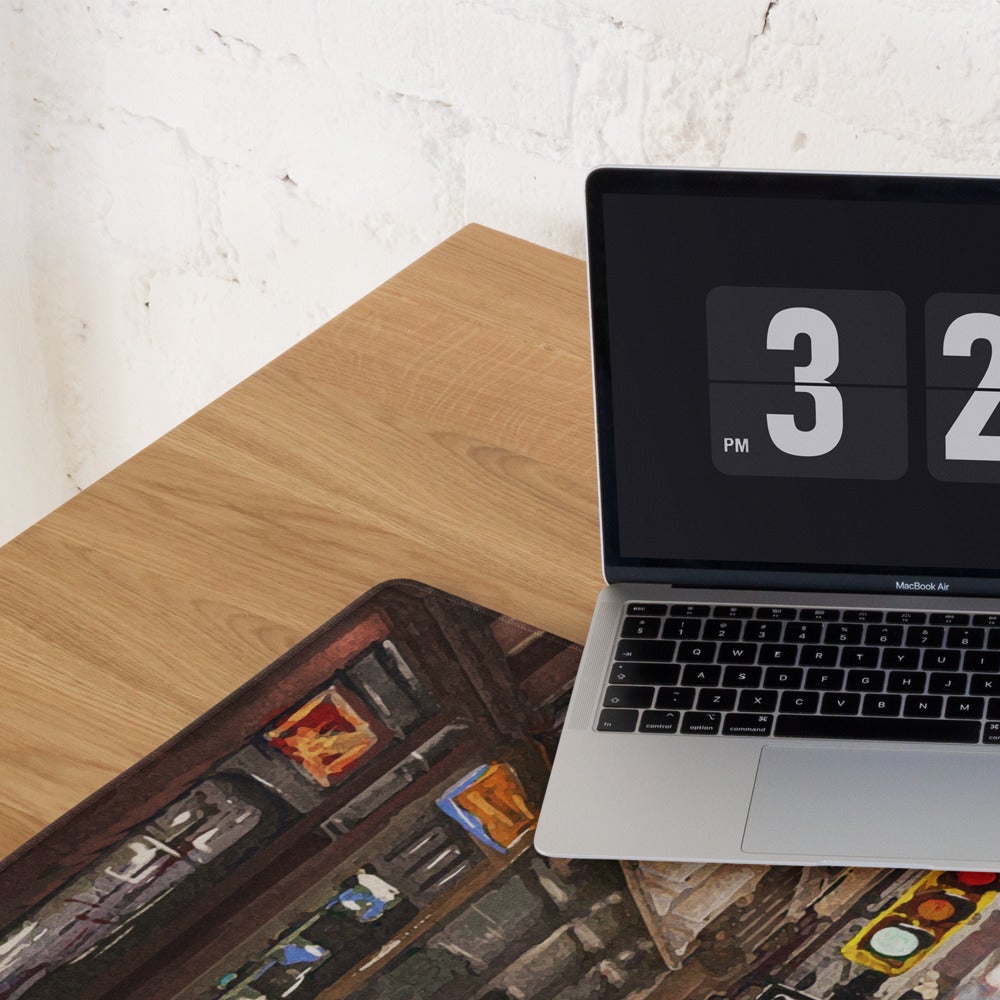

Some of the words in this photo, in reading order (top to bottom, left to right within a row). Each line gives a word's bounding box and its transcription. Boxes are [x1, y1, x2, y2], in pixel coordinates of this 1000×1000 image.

[766, 306, 844, 457] 3
[723, 437, 749, 454] PM
[895, 581, 936, 591] MacBook
[936, 582, 950, 591] Air
[692, 648, 701, 656] Q
[732, 649, 744, 657] W
[856, 653, 864, 661] T
[937, 656, 946, 664] U
[697, 671, 705, 679] A
[738, 672, 747, 680] S
[821, 675, 828, 683] F
[712, 695, 721, 703] Z
[795, 698, 804, 706] C
[837, 699, 846, 707] V
[877, 701, 886, 709] B
[918, 702, 928, 710] N
[729, 725, 767, 733] command
